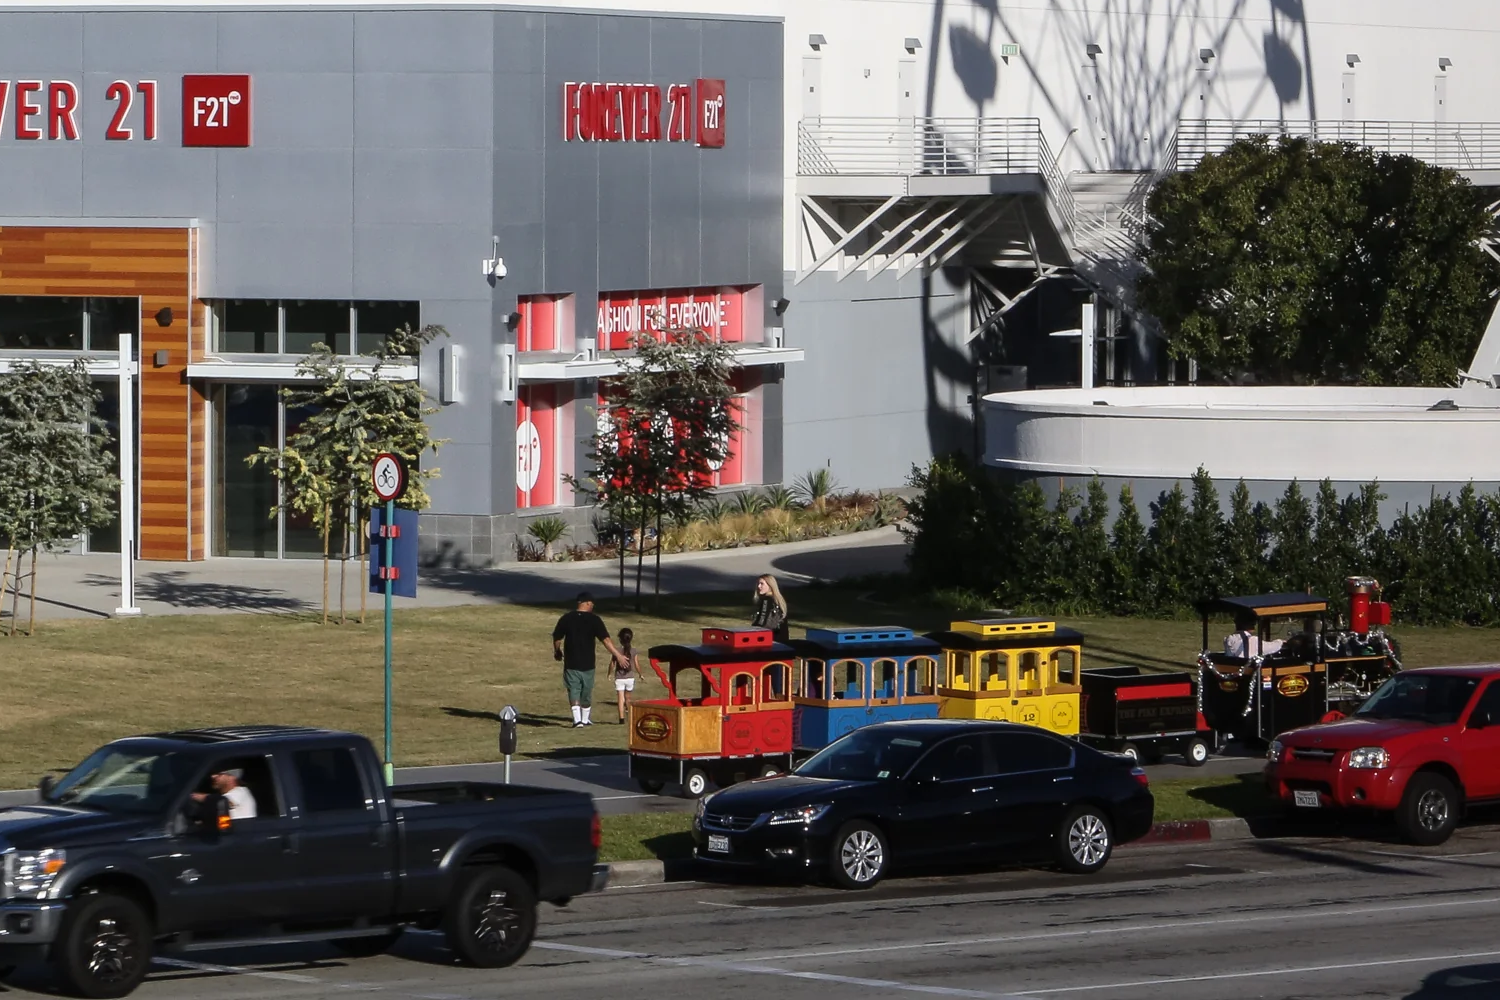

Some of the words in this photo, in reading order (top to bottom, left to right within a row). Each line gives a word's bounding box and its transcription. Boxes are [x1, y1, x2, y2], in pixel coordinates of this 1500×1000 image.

[105, 79, 158, 141] 21
[193, 96, 228, 127] F21
[563, 81, 661, 142] FOREVER
[667, 83, 692, 142] 21
[704, 99, 719, 129] F21
[1023, 713, 1035, 722] 12
